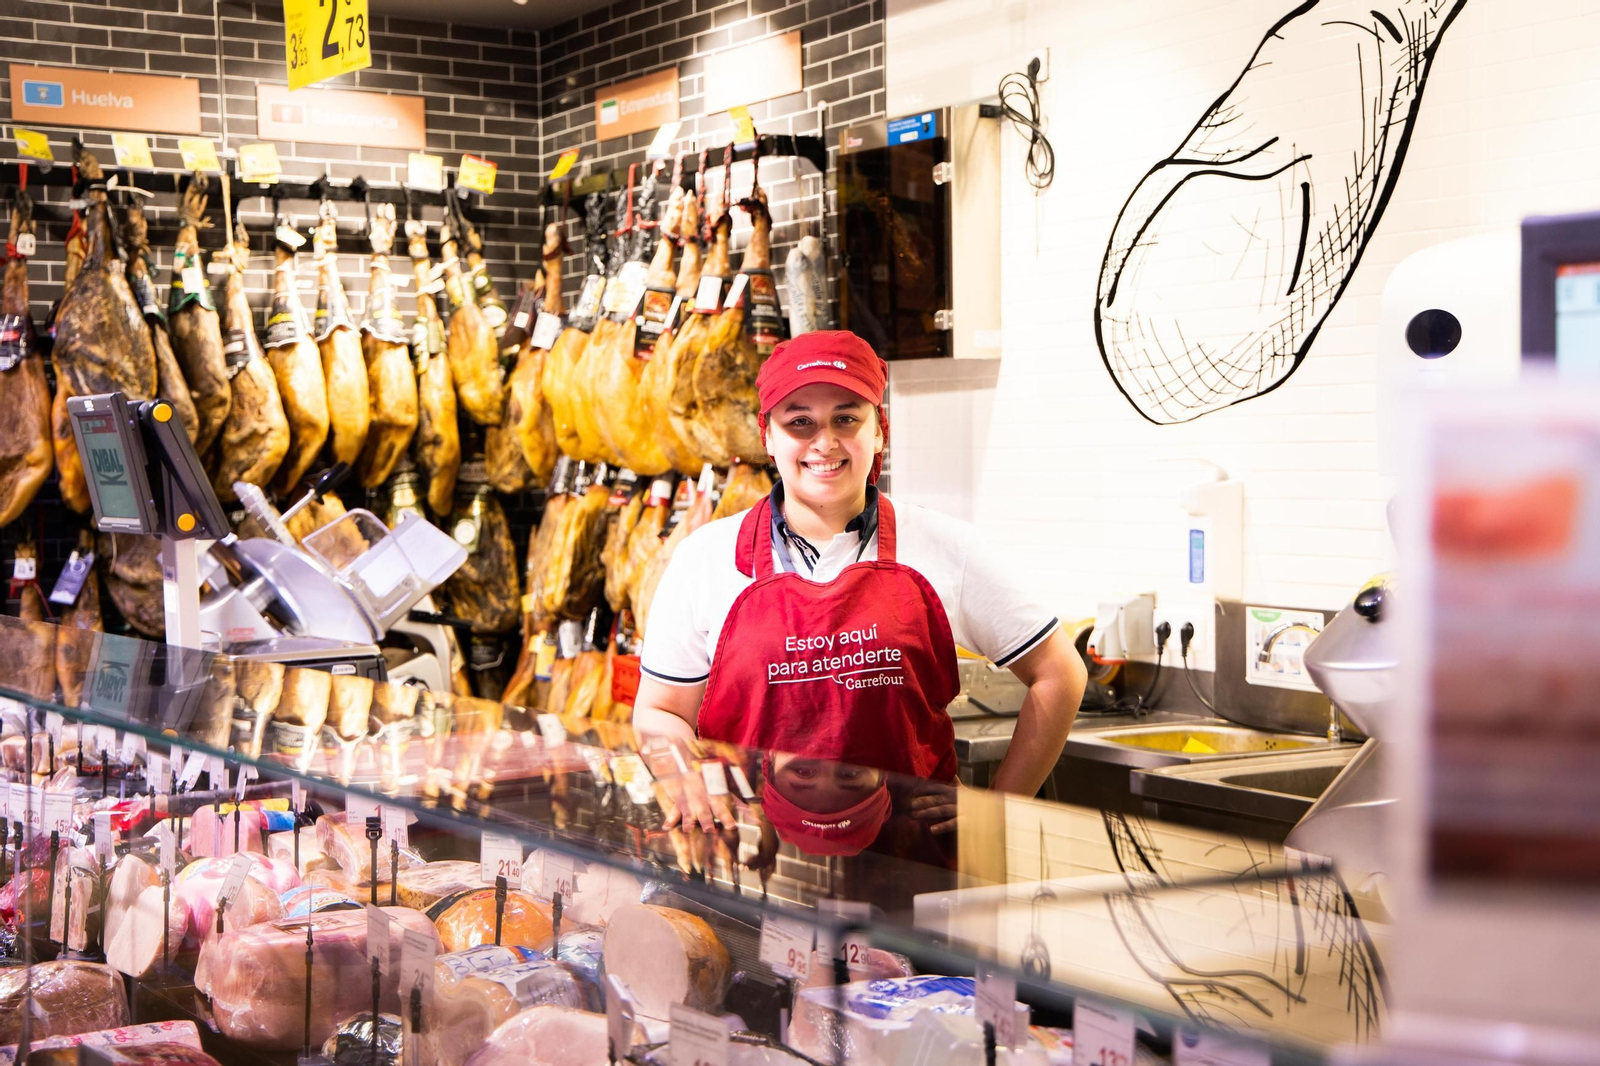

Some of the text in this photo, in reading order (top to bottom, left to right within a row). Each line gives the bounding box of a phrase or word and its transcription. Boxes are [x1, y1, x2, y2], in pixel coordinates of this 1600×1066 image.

[71, 88, 134, 109] Huelva
[797, 360, 831, 371] Carrefour
[92, 448, 125, 473] DIBAL
[785, 623, 878, 651] Estoy aquí
[767, 647, 902, 680] para atenderte
[845, 673, 904, 691] Carrefour
[498, 859, 511, 877] 21
[511, 867, 520, 878] 40
[787, 948, 796, 969] 9
[841, 942, 860, 964] 12
